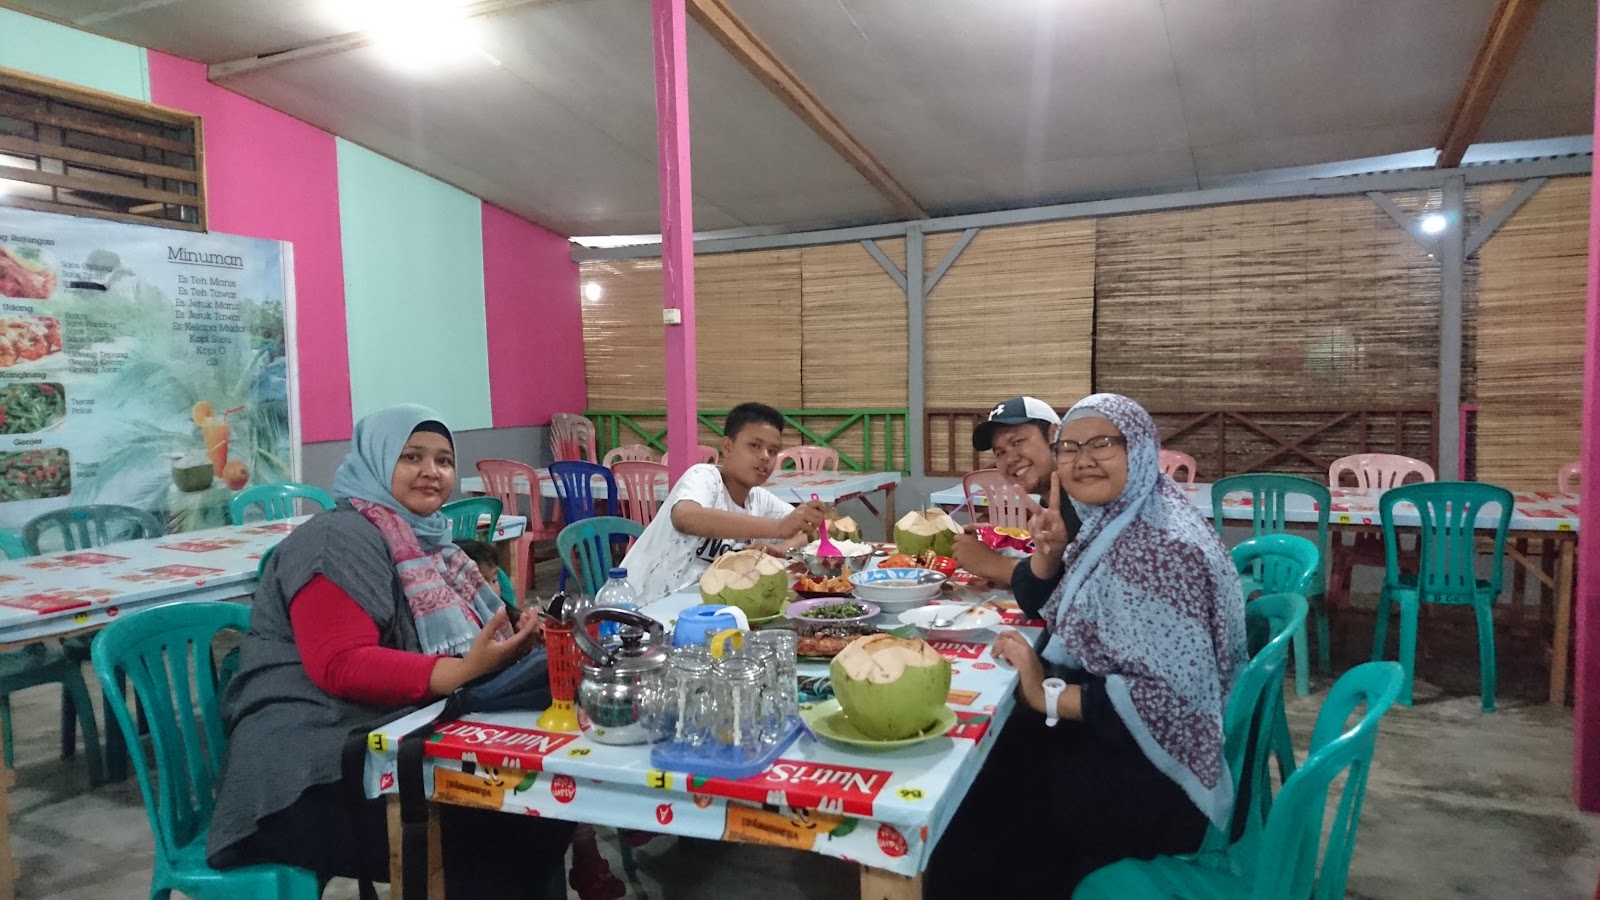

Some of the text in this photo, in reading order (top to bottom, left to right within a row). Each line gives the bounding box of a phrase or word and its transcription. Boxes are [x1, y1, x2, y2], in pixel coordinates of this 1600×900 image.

[11, 234, 54, 246] Rajungan
[167, 246, 243, 267] Minuman
[178, 275, 236, 287] Es Teh Manis
[178, 287, 236, 299] Es Teh Tawar
[2, 303, 34, 313] Udang
[175, 298, 241, 310] Es Jeruk Manis
[175, 310, 241, 321] Es Jeruk Tawar
[172, 322, 245, 333] Es Kelapa Muda
[189, 334, 231, 344] Kopi Susu
[196, 346, 216, 356] Kopi
[0, 371, 47, 379] Kangkung
[373, 734, 383, 751] E
[654, 770, 666, 789] E
[761, 763, 878, 795] NutriS
[552, 788, 576, 799] Asam
[900, 788, 922, 798] B6
